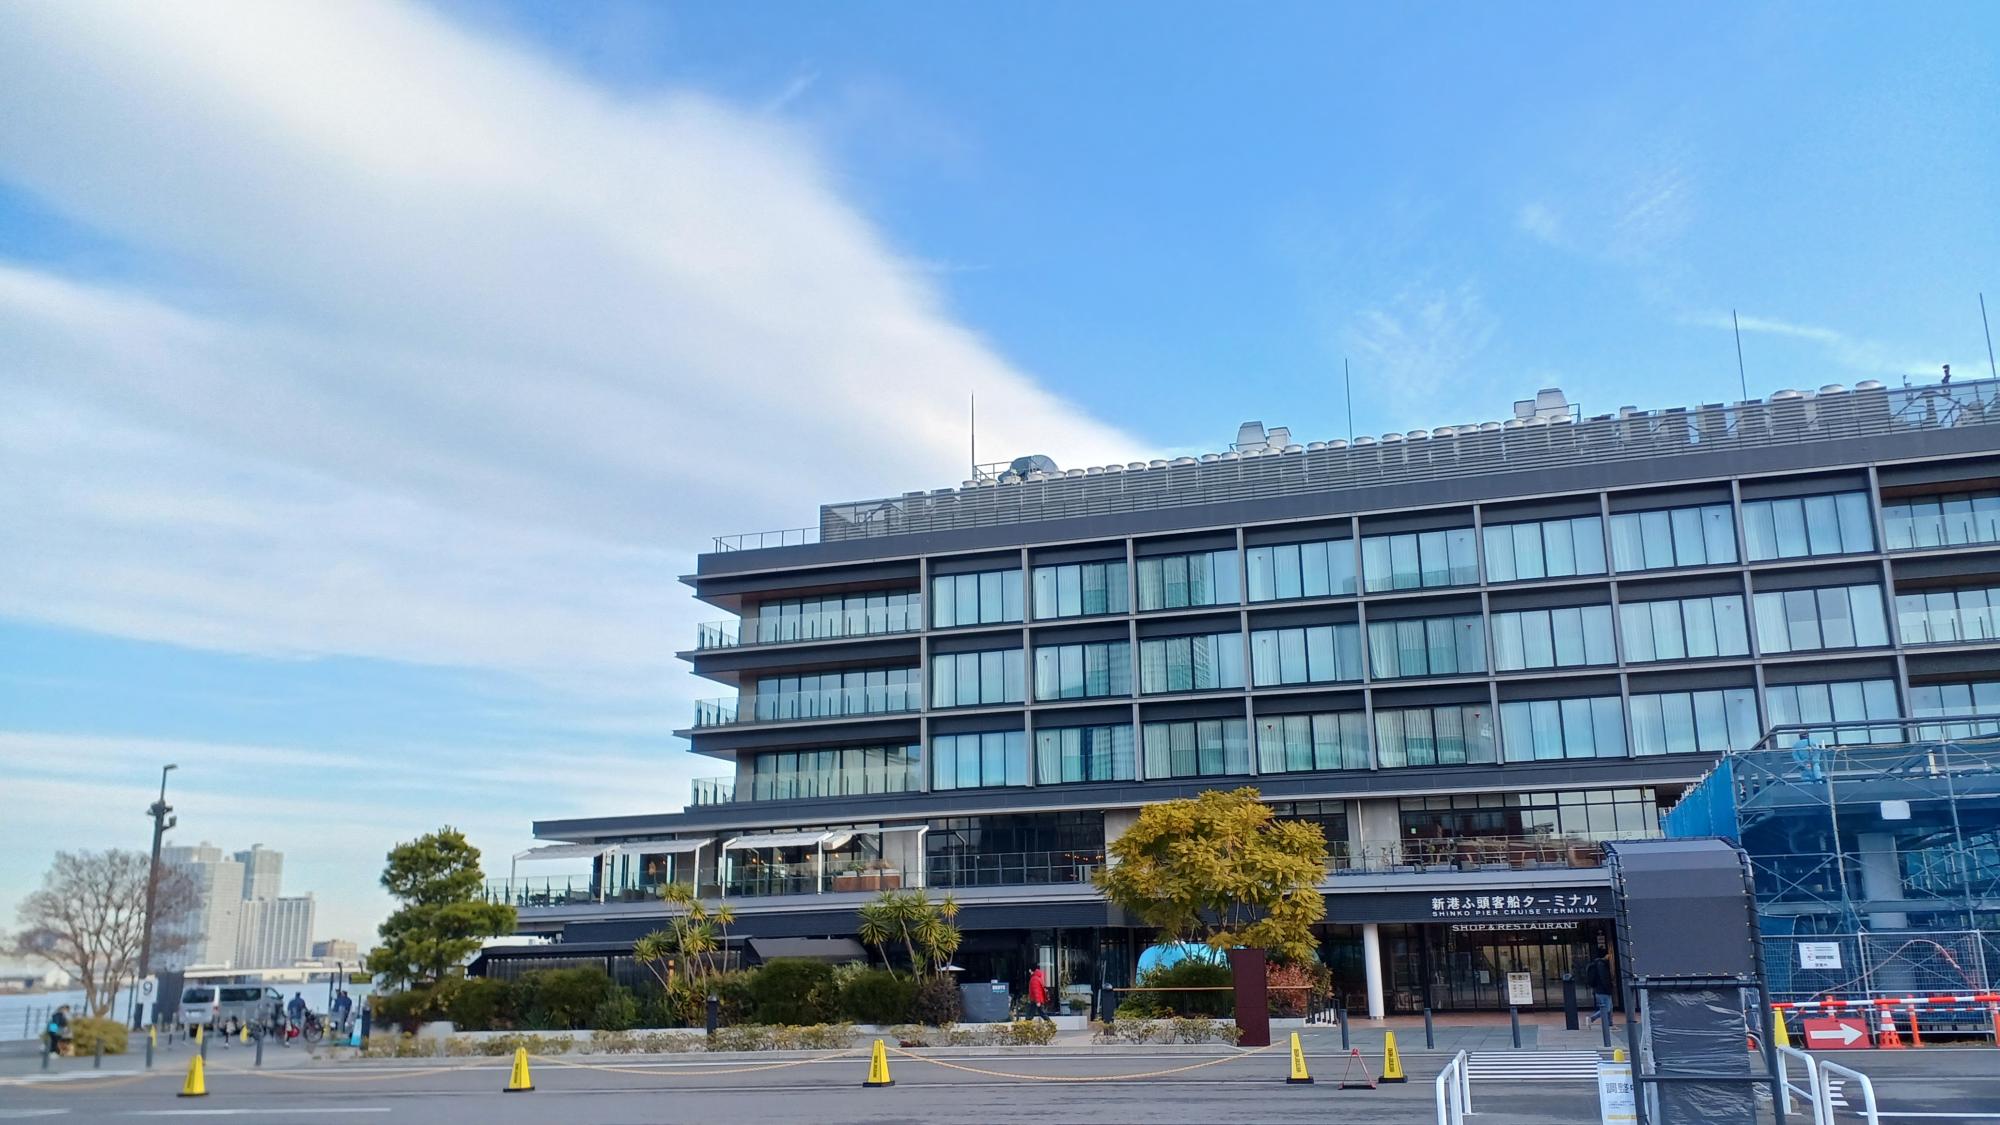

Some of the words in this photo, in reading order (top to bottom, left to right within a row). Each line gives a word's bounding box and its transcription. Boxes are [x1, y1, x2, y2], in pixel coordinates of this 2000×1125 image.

[1431, 894, 1598, 911] 新港ふ頭客船ターミナル
[143, 981, 153, 996] 9
